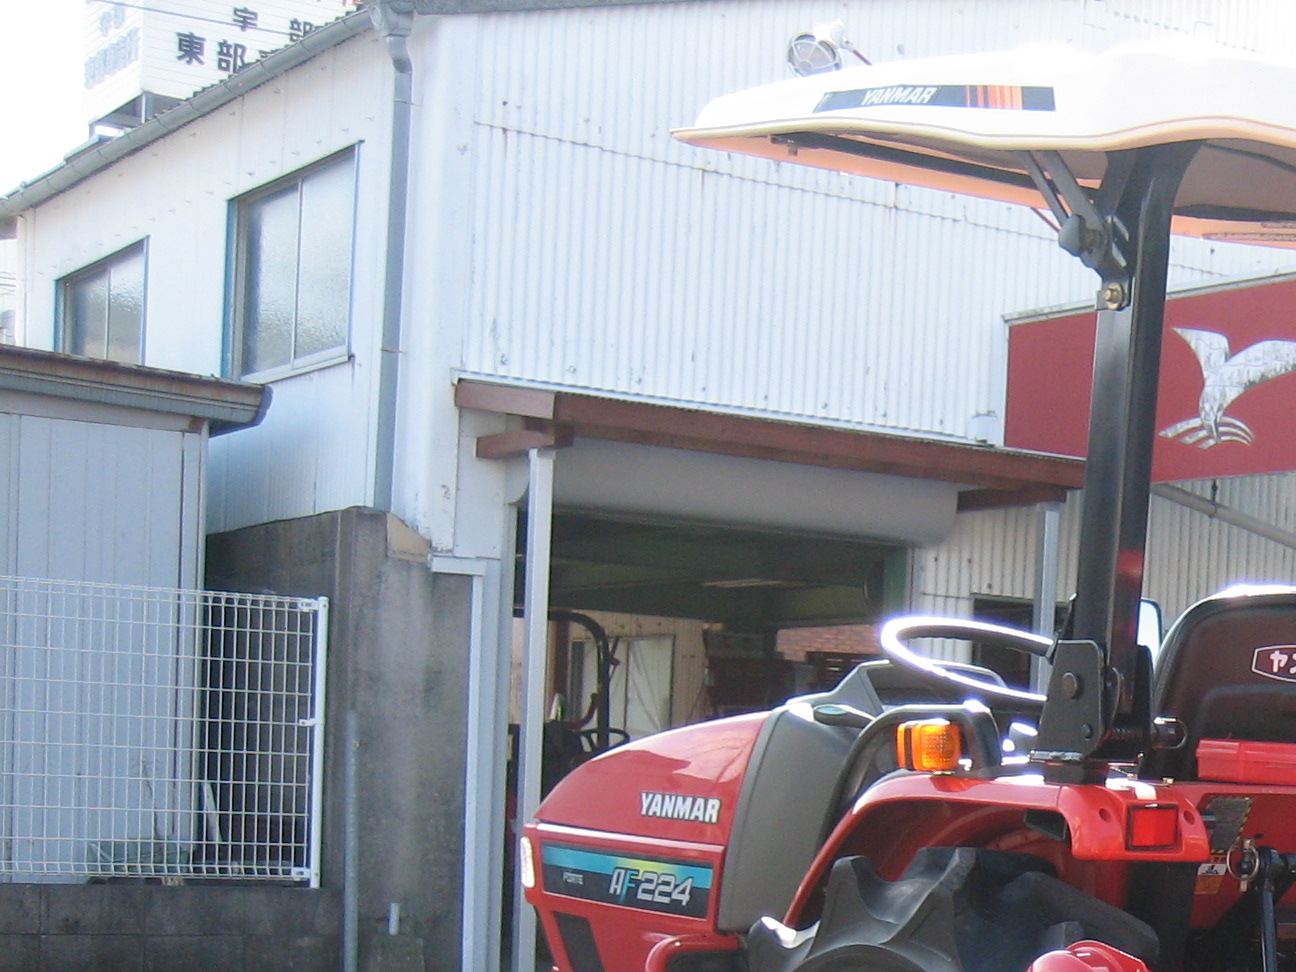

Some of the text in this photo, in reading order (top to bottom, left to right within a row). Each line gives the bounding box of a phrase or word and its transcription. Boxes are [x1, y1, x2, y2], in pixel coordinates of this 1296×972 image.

[176, 32, 276, 73] 東部
[860, 86, 938, 106] YANMAR
[640, 791, 721, 824] YANMAR
